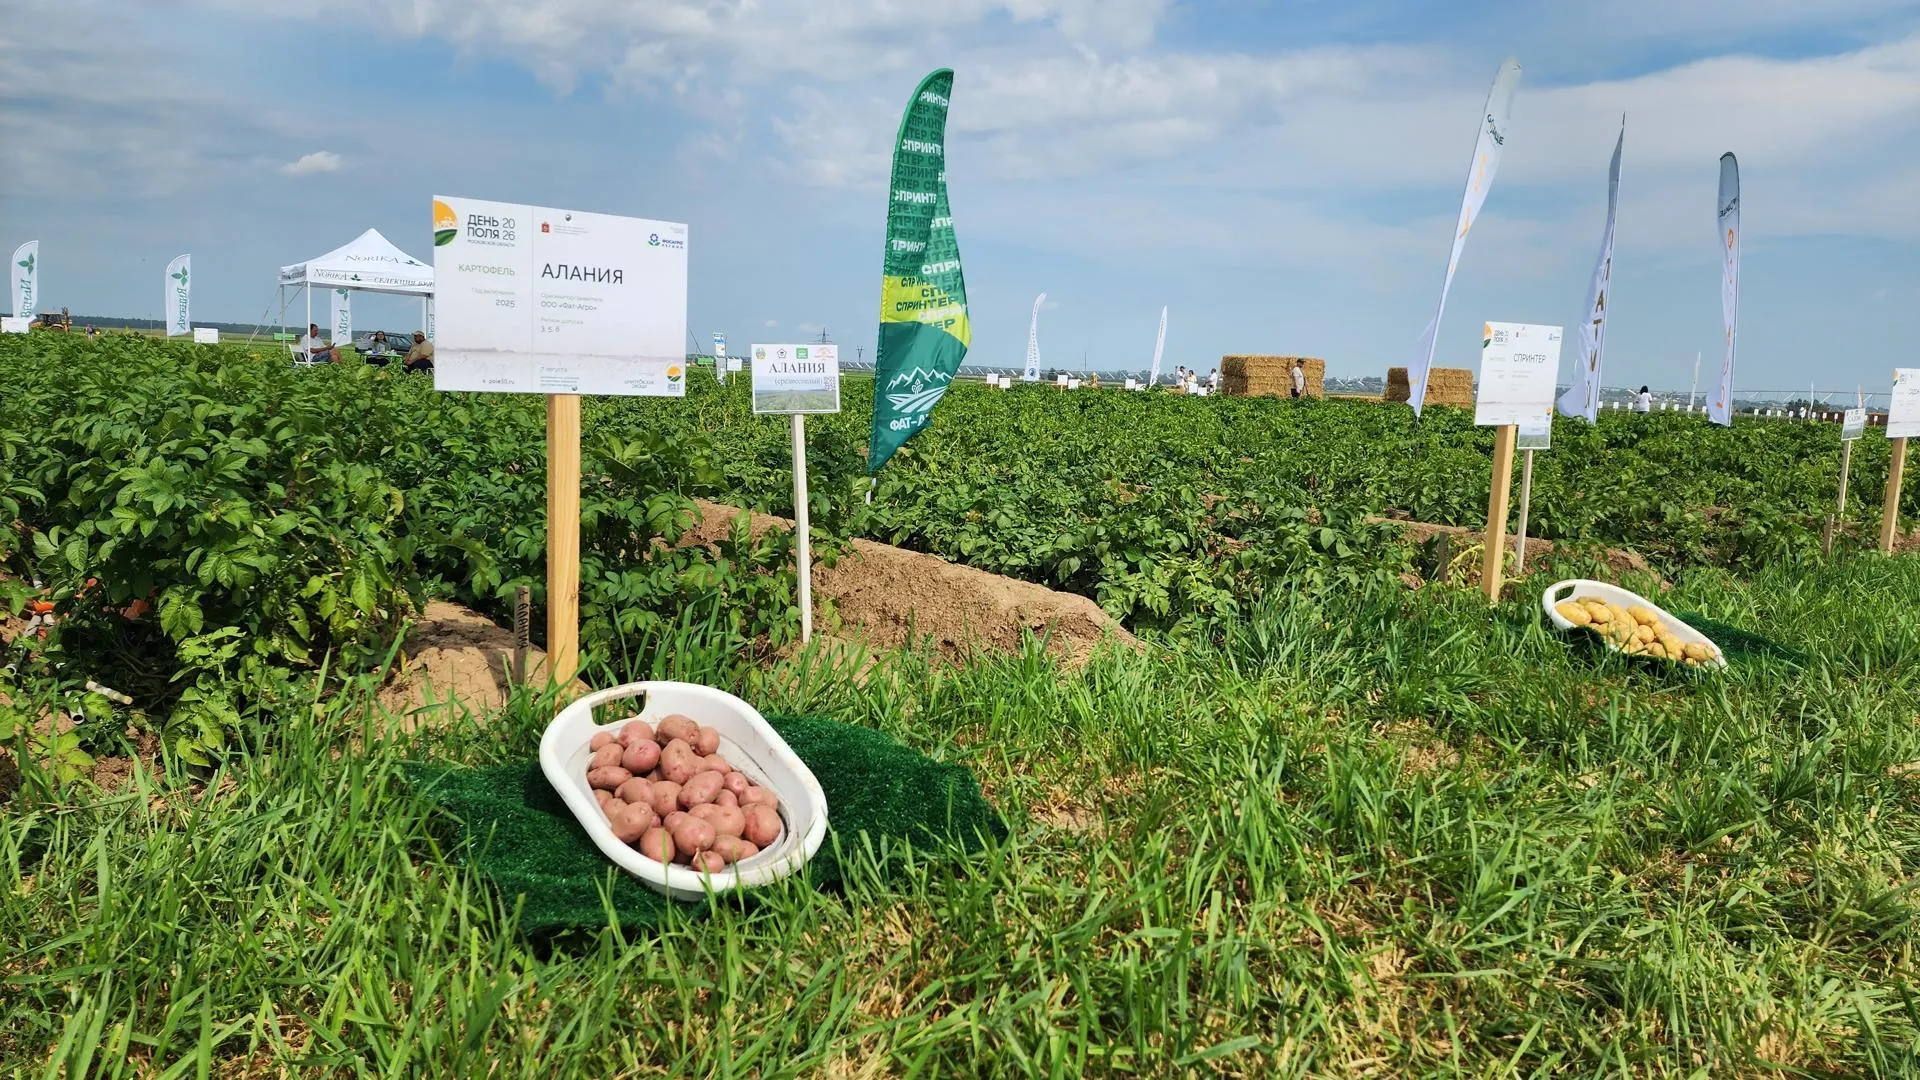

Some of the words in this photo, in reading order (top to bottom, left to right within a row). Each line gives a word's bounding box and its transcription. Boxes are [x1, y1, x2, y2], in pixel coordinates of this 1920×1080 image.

[467, 214, 499, 227] ДЕНЬ
[502, 217, 515, 229] 20
[467, 226, 500, 239] ПОЛЯ
[502, 230, 515, 241] 26
[458, 263, 515, 276] КАРТОФЕЛЬ
[541, 263, 623, 284] АЛАНИЯ
[1513, 353, 1546, 364] СПРИНТЕР
[769, 362, 825, 374] АЛАНИЯ
